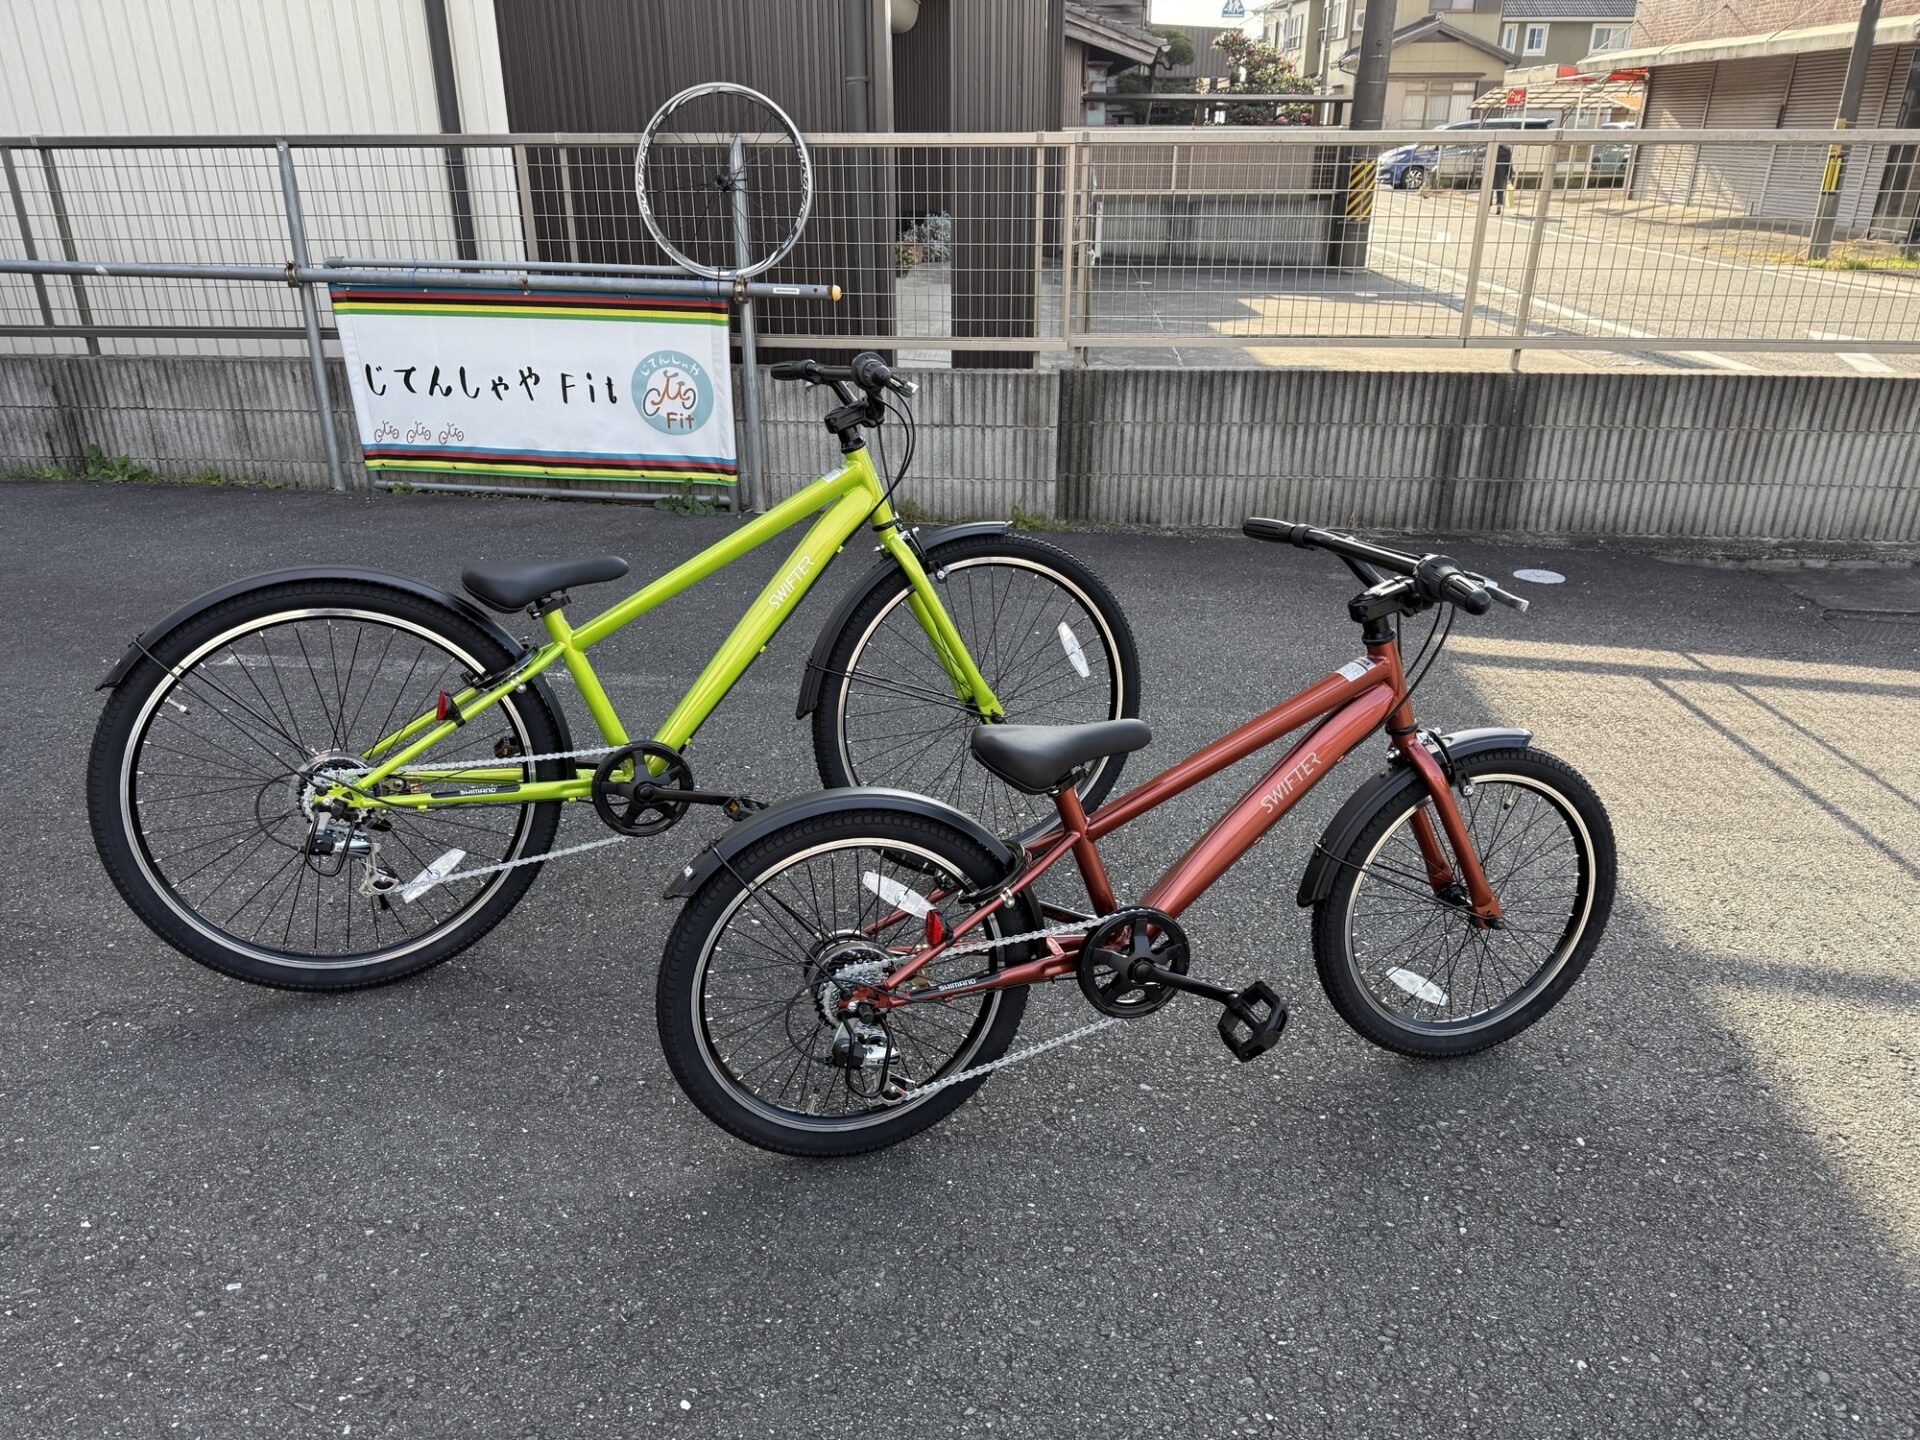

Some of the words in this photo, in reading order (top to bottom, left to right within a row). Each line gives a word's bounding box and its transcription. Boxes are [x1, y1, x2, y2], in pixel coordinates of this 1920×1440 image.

[640, 353, 700, 376] じてんしゃや
[365, 363, 540, 402] じてんしゃや
[560, 371, 618, 404] Fit
[666, 411, 695, 430] Fit
[768, 555, 814, 610] SWIFTER
[460, 787, 496, 796] SHIMANO
[1261, 752, 1321, 814] SWIFTER
[938, 978, 977, 992] SHIMANO
